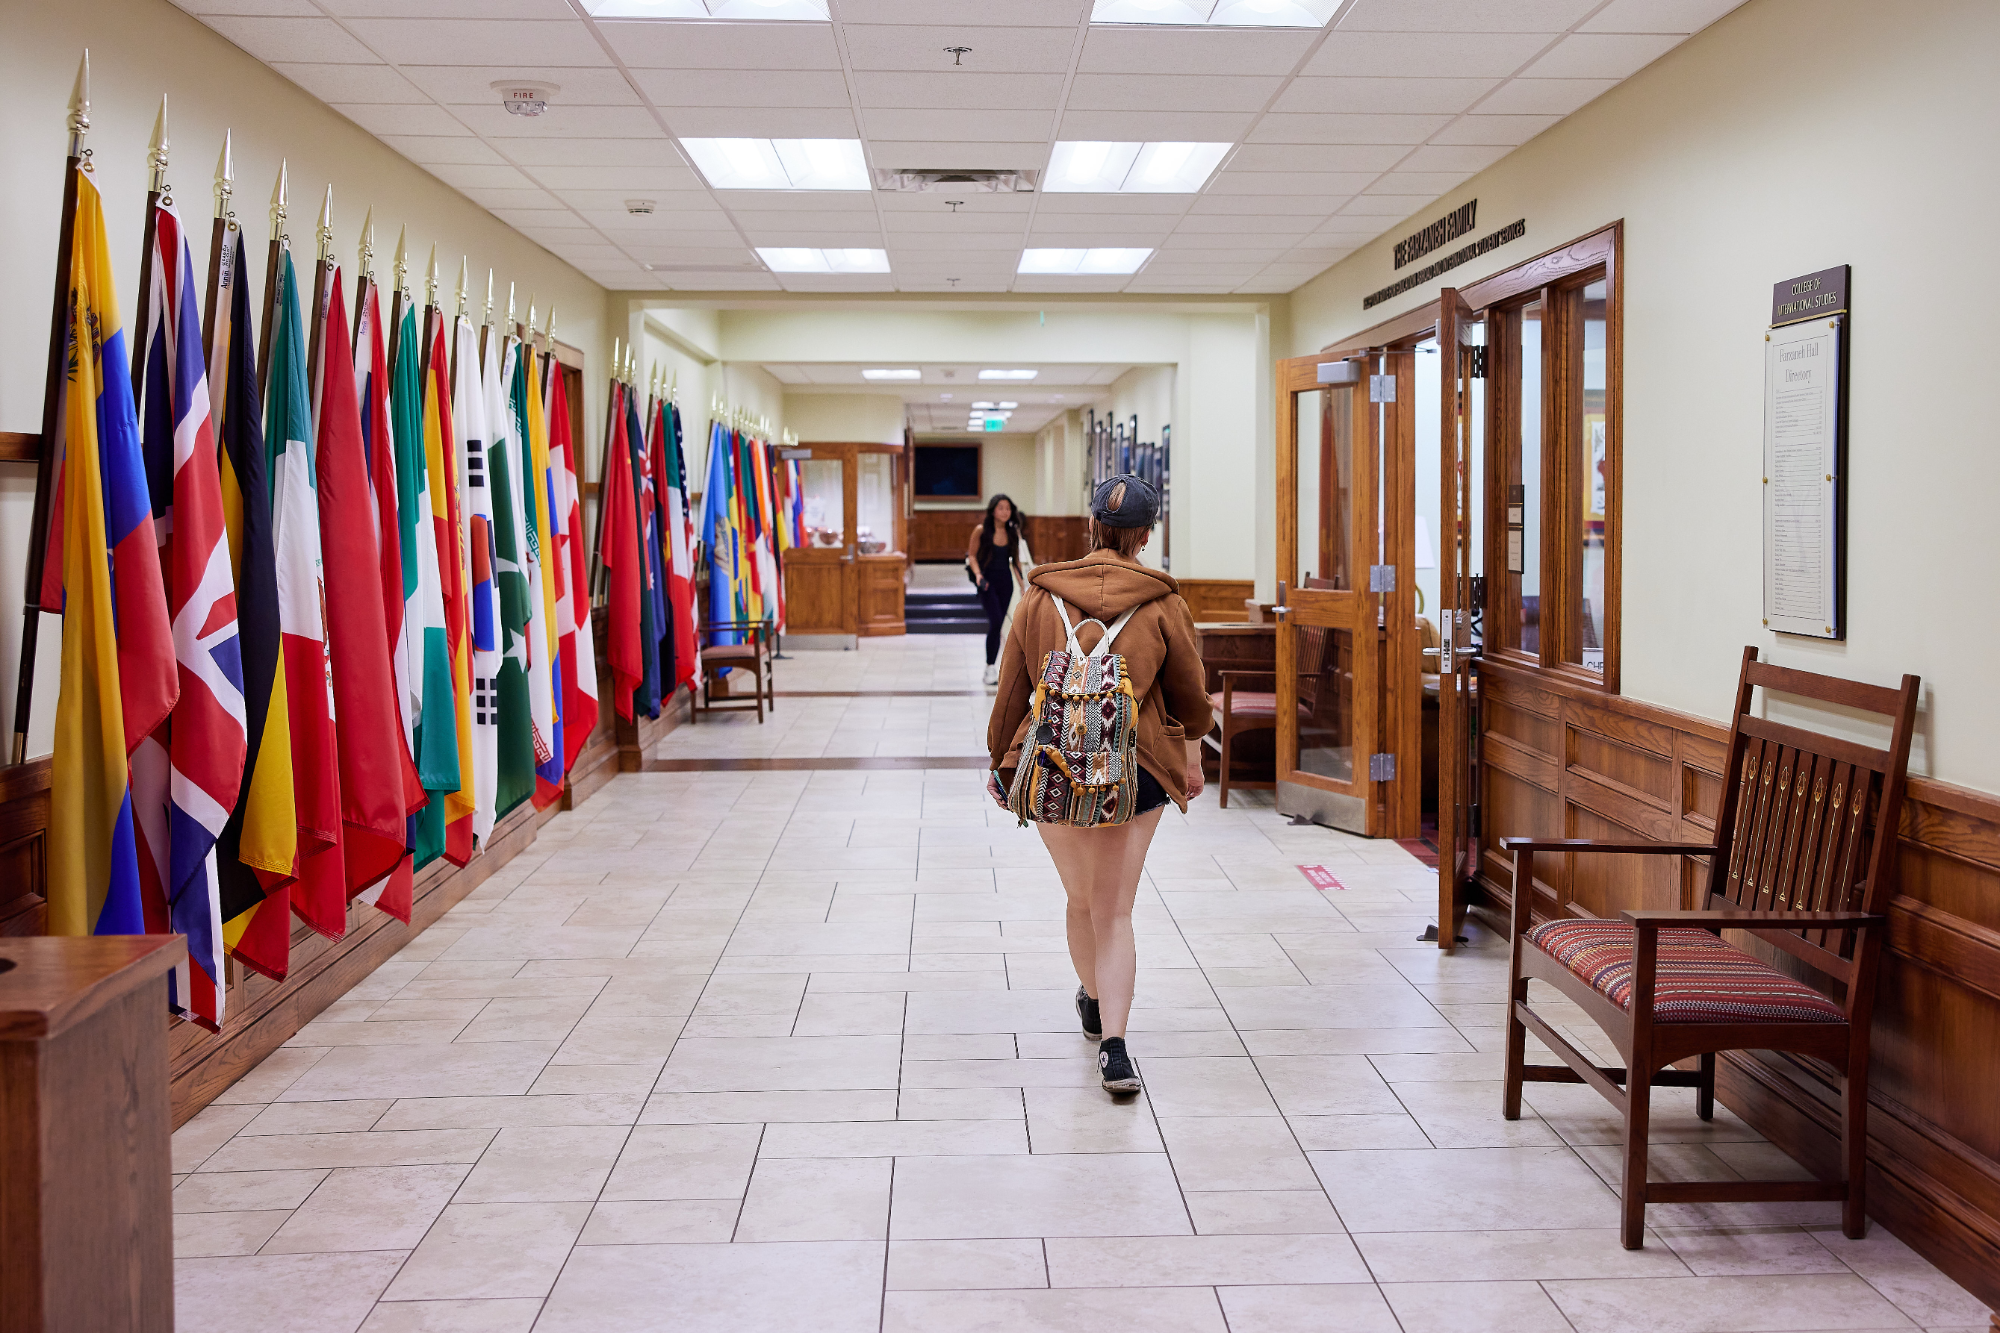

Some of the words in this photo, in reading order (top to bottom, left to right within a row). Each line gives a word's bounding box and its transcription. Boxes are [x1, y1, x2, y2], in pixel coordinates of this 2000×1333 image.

[1393, 239, 1408, 271] THE
[1407, 216, 1446, 263] FARZANEH
[1447, 198, 1477, 242] FAMILY
[1477, 231, 1500, 256] STUDENT
[1500, 219, 1525, 245] SERVICES
[1791, 279, 1814, 296] COLLEGE
[1814, 277, 1822, 291] OF
[1777, 297, 1814, 316] INTERNATIONAL
[1815, 291, 1837, 308] STUDIES
[1806, 342, 1819, 358] Hall
[1785, 369, 1812, 384] Directory
